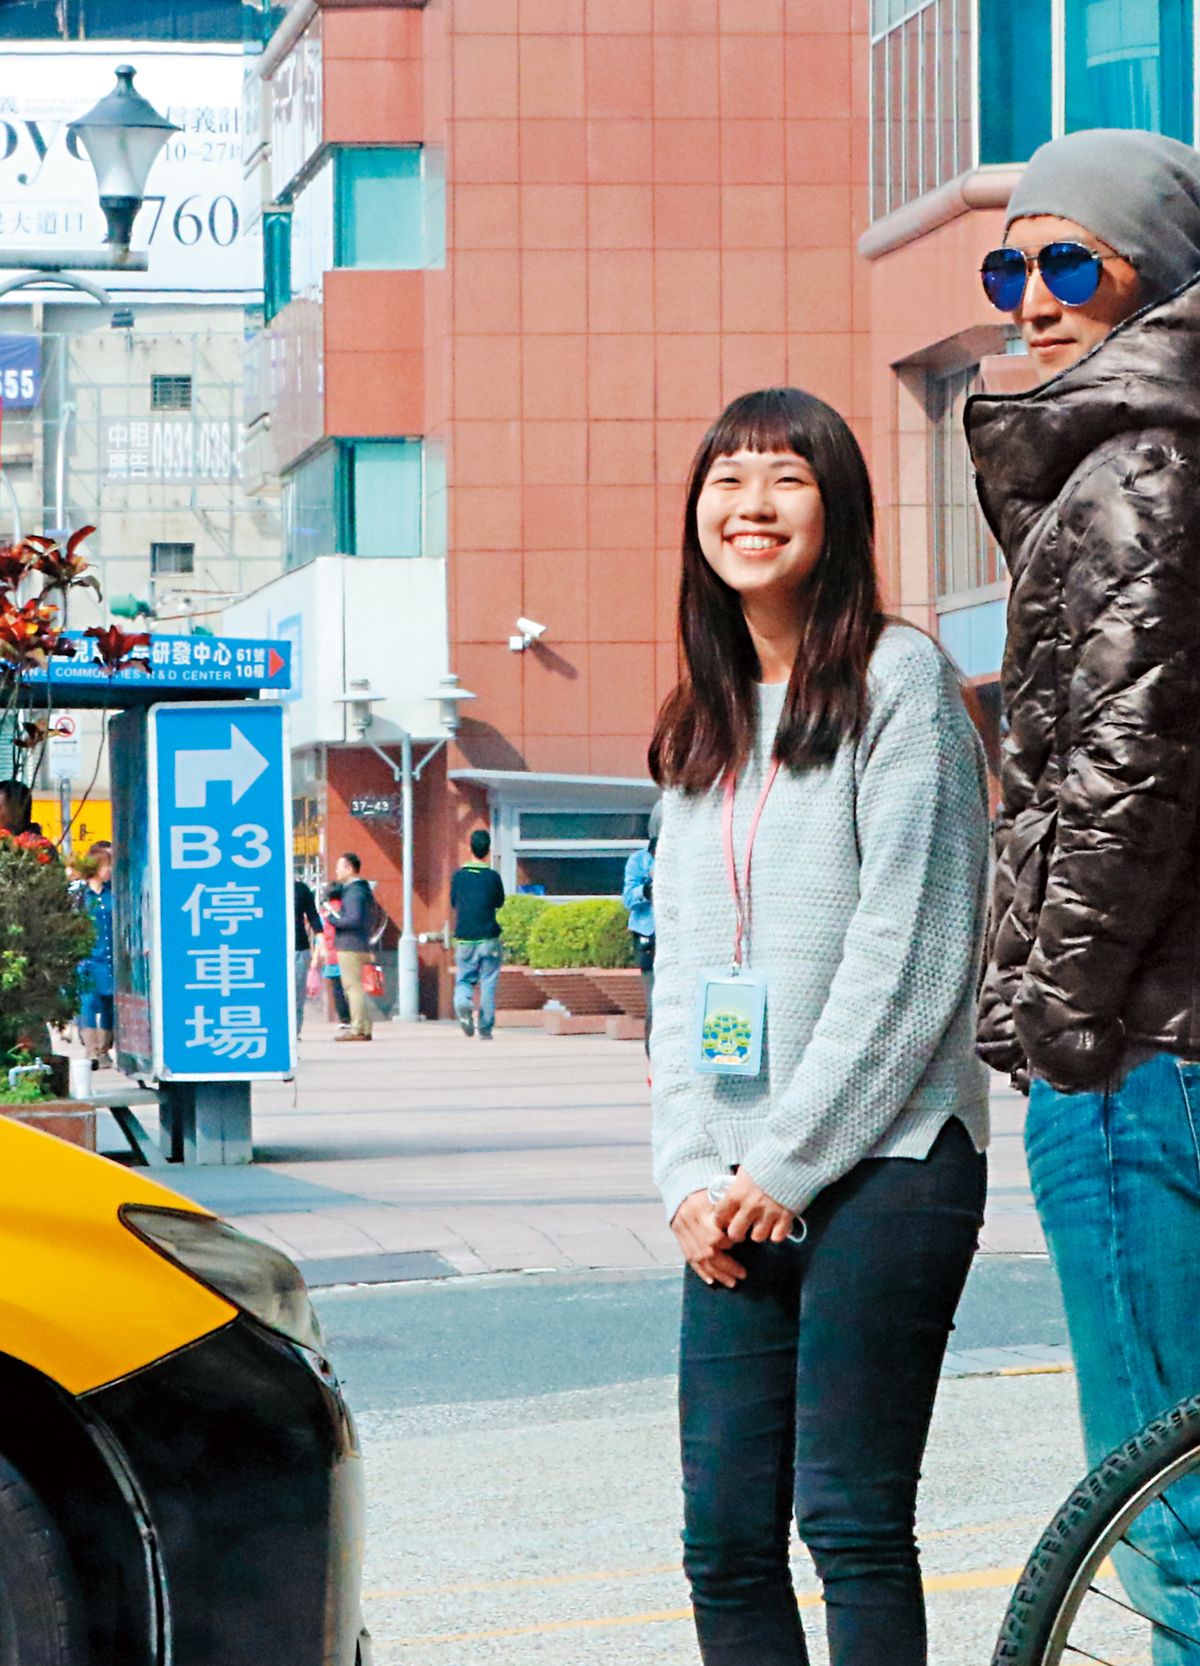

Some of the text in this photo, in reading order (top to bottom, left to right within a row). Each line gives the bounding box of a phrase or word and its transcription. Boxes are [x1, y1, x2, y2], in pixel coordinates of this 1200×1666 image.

[0, 369, 34, 399] 55
[182, 670, 232, 681] CENTER
[170, 823, 272, 870] B3
[181, 881, 268, 1060] 停車場
